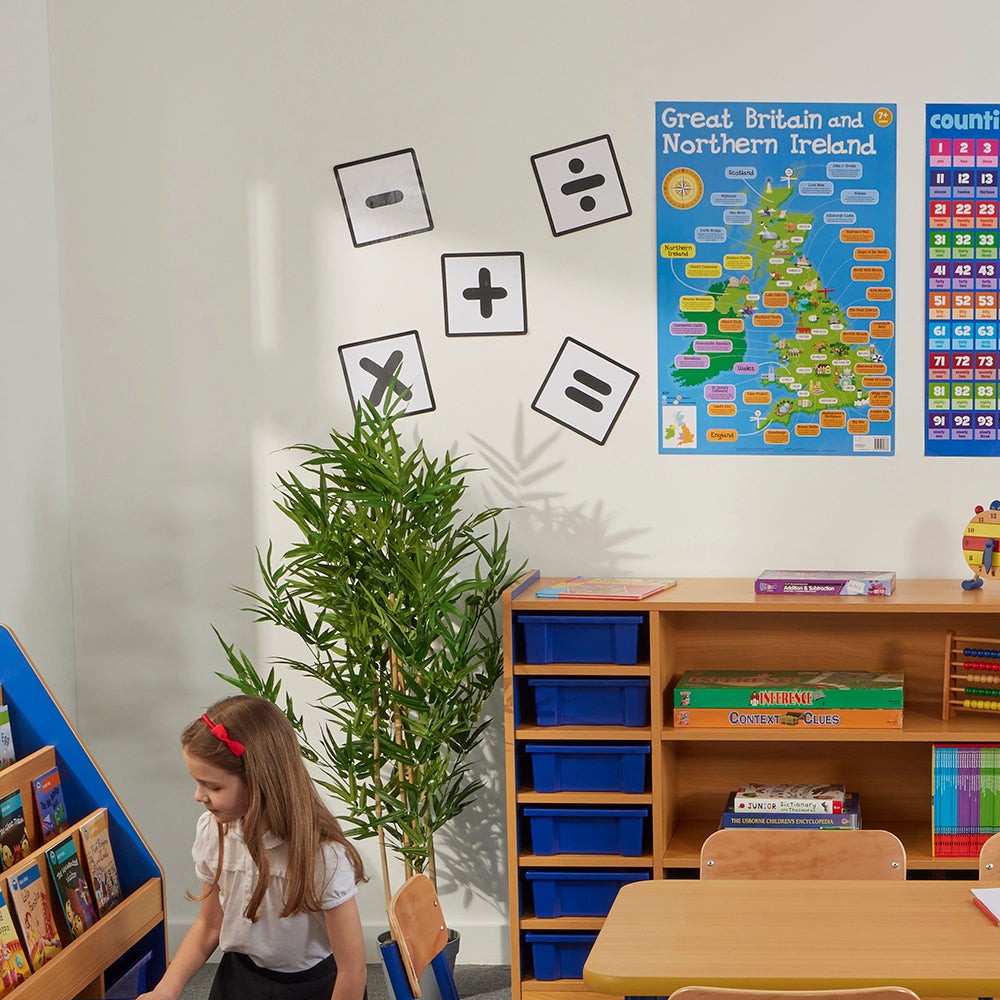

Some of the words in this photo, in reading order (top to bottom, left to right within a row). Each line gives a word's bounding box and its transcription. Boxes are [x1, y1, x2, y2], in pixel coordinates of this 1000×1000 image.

[661, 107, 734, 129] Great
[745, 107, 823, 130] Britain
[828, 112, 864, 128] and
[877, 111, 889, 120] 7+
[662, 133, 778, 155] Northern
[790, 133, 876, 155] Ireland
[959, 142, 969, 153] 2
[983, 142, 992, 154] 3
[936, 173, 945, 184] 11
[958, 172, 970, 184] 12
[981, 173, 994, 185] 13
[934, 203, 947, 215] 21
[955, 203, 972, 215] 22
[978, 203, 995, 215] 23
[933, 415, 946, 426] 91
[954, 415, 971, 427] 92
[977, 415, 994, 427] 93
[760, 691, 812, 706] INFERENCE
[729, 711, 780, 725] CONTEXT
[803, 712, 840, 725] CLUES
[1, 732, 10, 746] Egg
[780, 801, 816, 809] Dictionary
